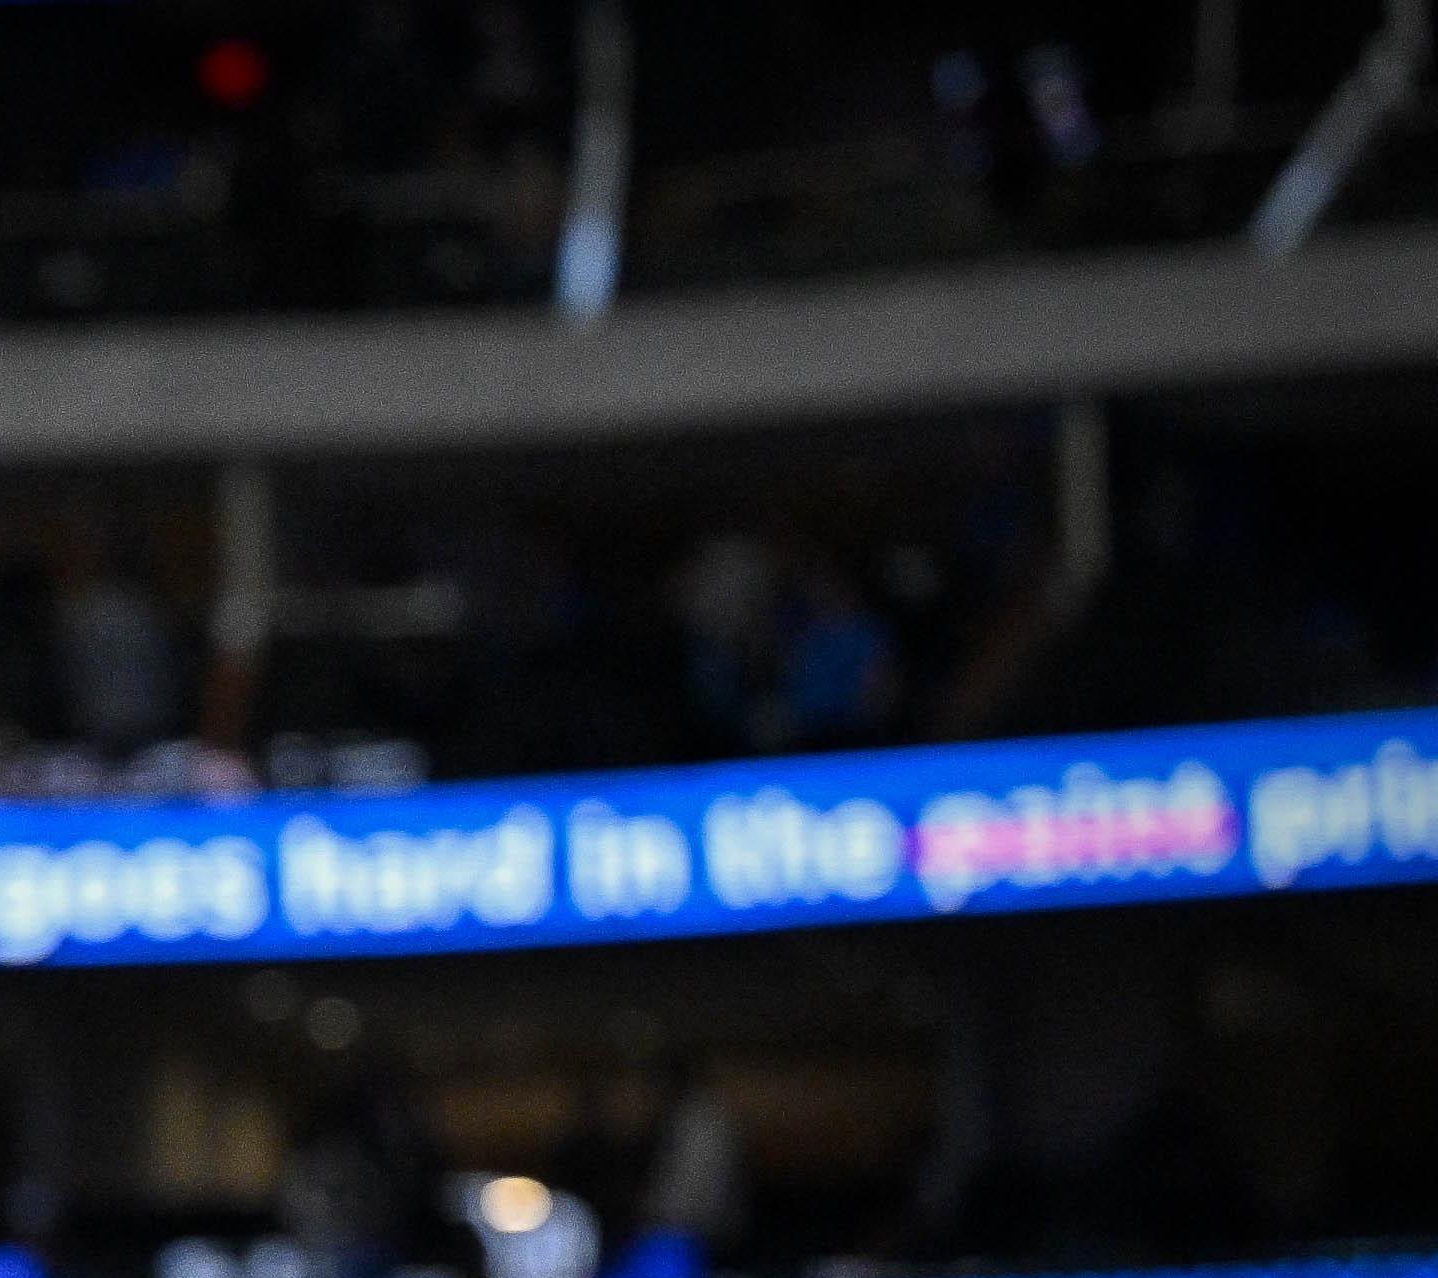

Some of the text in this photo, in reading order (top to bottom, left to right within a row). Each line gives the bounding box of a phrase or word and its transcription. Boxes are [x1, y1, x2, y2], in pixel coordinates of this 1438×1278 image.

[278, 802, 555, 935] hard
[565, 798, 691, 921] in
[701, 782, 904, 912] the
